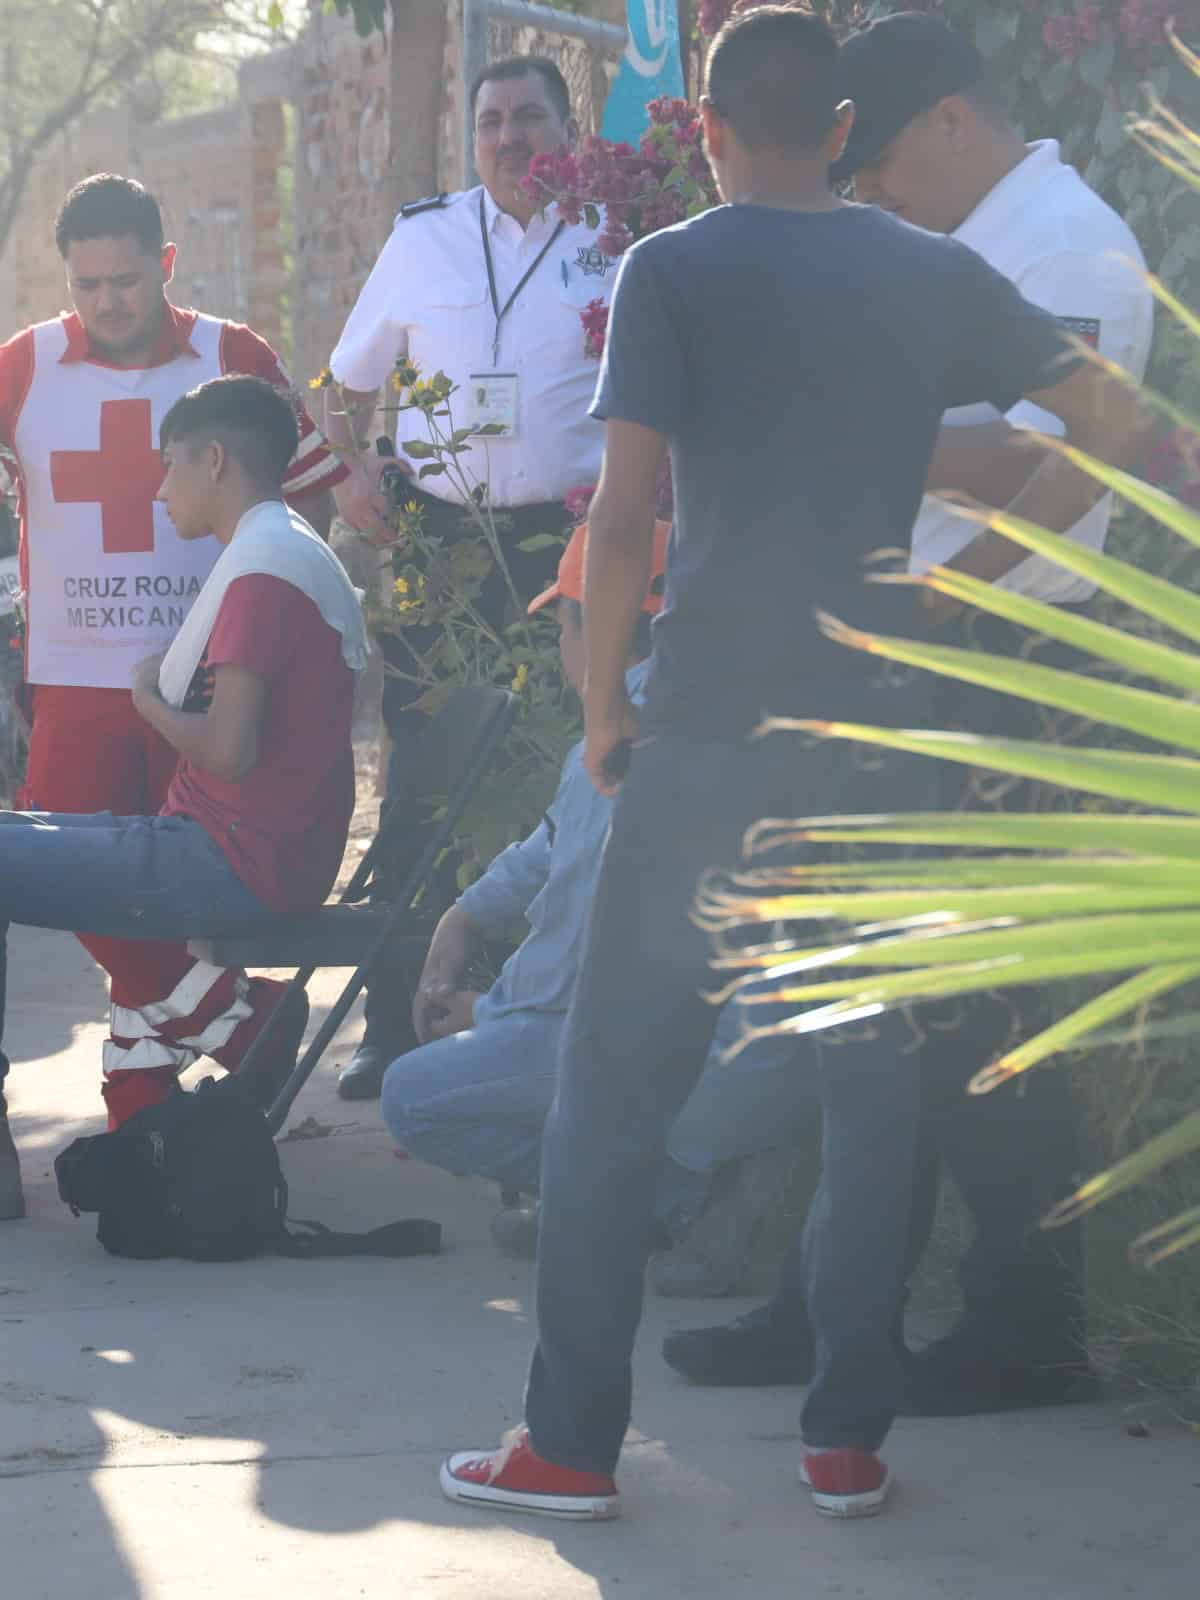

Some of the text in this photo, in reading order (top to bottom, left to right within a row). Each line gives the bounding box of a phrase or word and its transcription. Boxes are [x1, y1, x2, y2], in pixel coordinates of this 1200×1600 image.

[63, 575, 202, 598] CRUZ ROJA
[66, 605, 185, 629] MEXICAN
